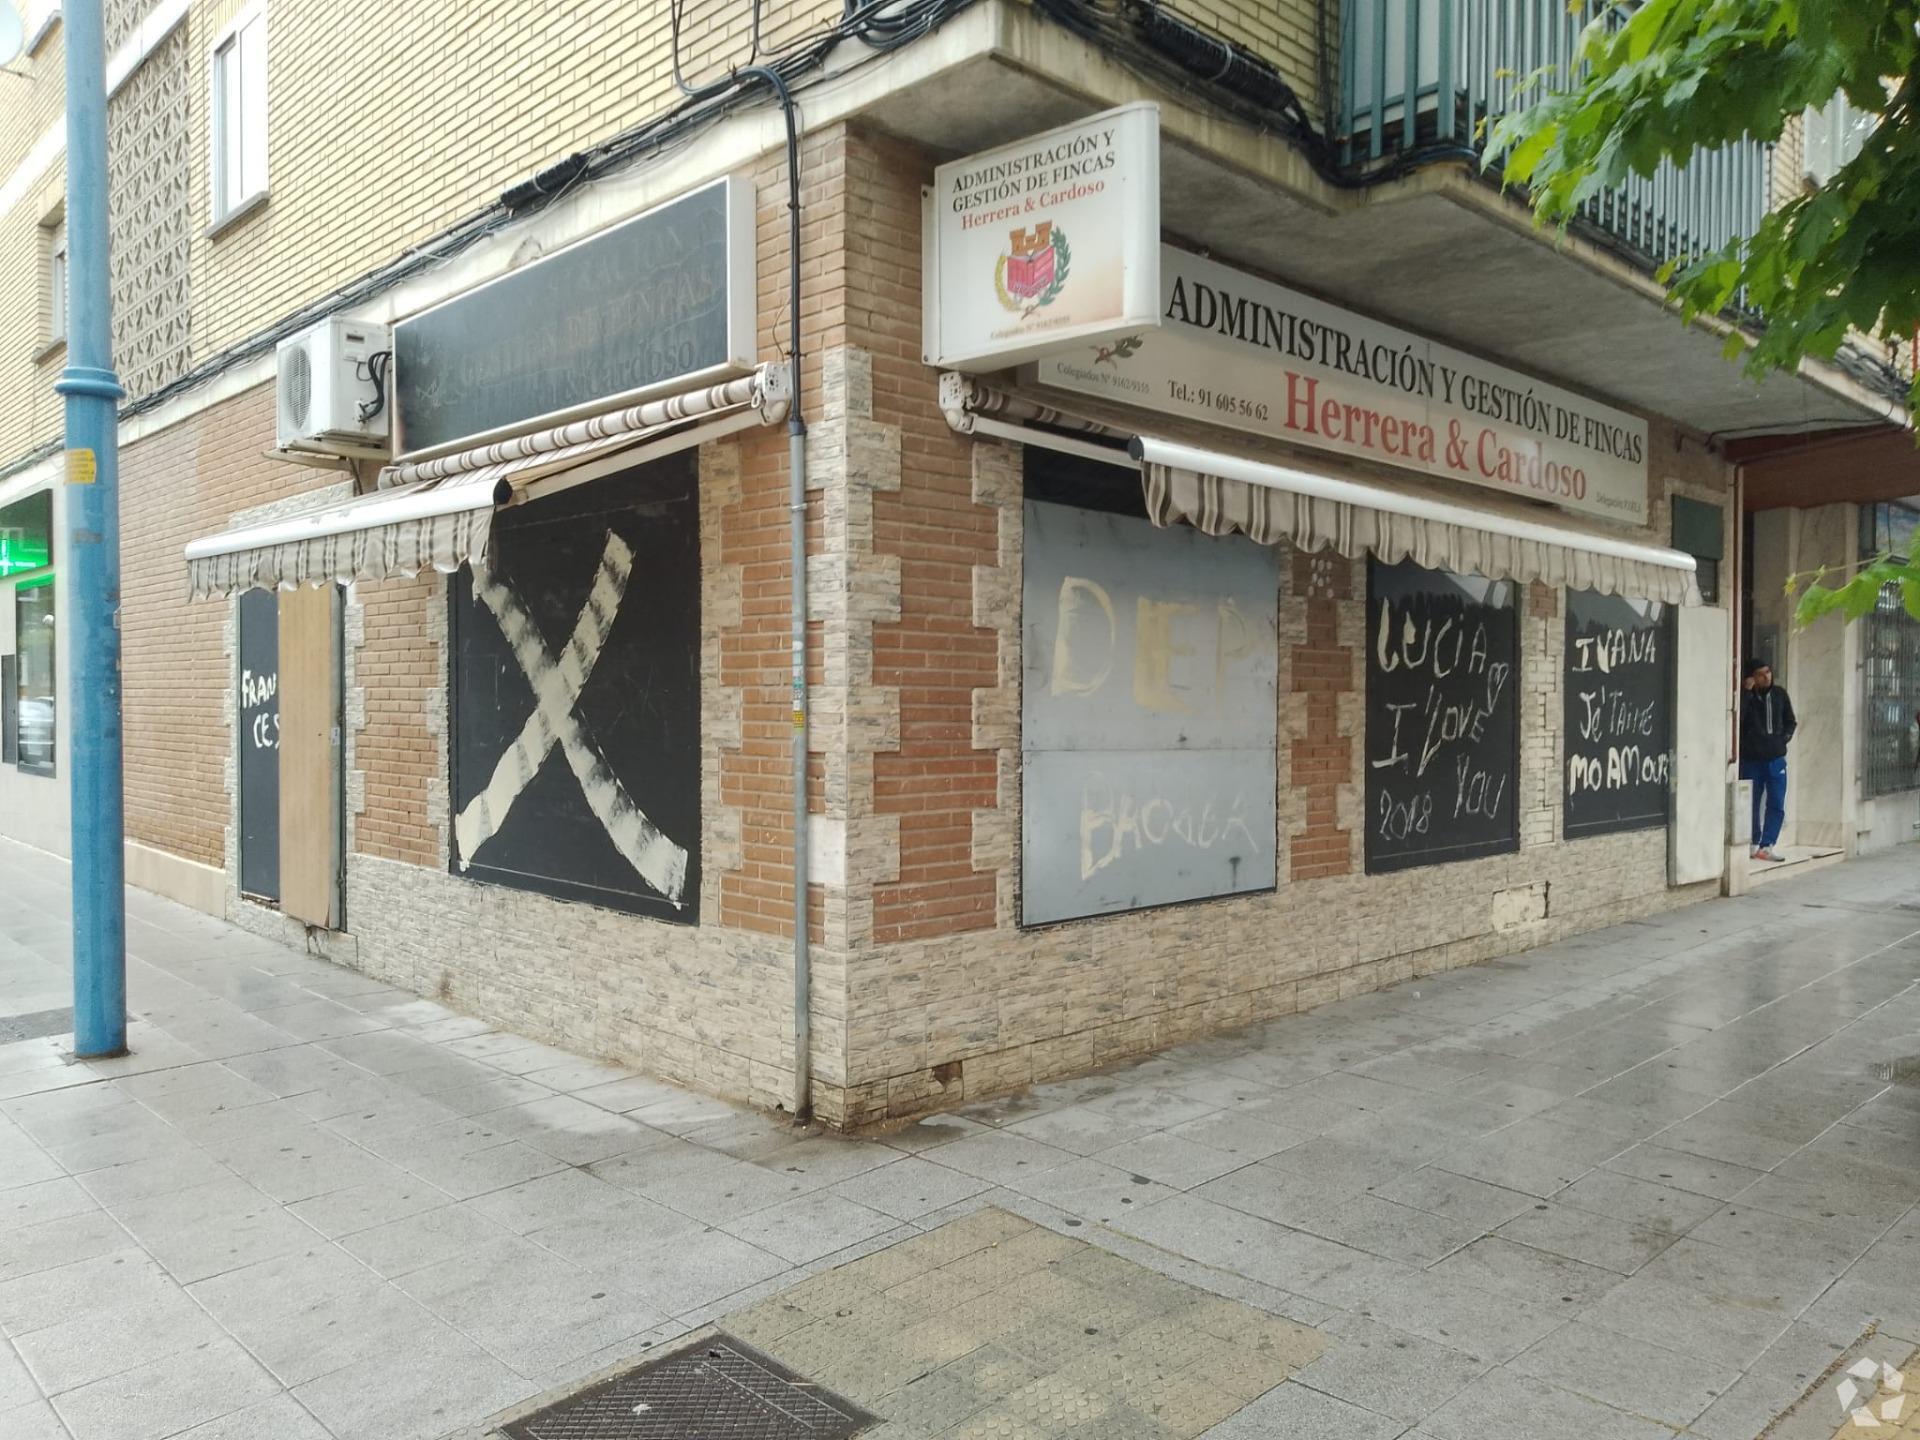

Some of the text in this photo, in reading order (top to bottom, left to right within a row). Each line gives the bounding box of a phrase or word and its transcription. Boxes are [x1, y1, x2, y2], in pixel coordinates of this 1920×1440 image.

[952, 129, 1115, 193] ADMINISTRACIÓN Y
[952, 151, 1116, 213] GESTIÓN DE FINCAS
[962, 180, 1105, 230] Herrera & Cardoso
[1165, 276, 1642, 464] ADMINISTRACIÓN Y GESTIÓN DE FINCAS
[1168, 379, 1269, 421] Tel.: 91 605 56 62
[1284, 371, 1587, 500] Herrera & Cardoso
[1572, 628, 1656, 674] IVANA
[241, 670, 277, 709] FRAN
[1372, 703, 1416, 769] I
[1454, 752, 1506, 820] YOU
